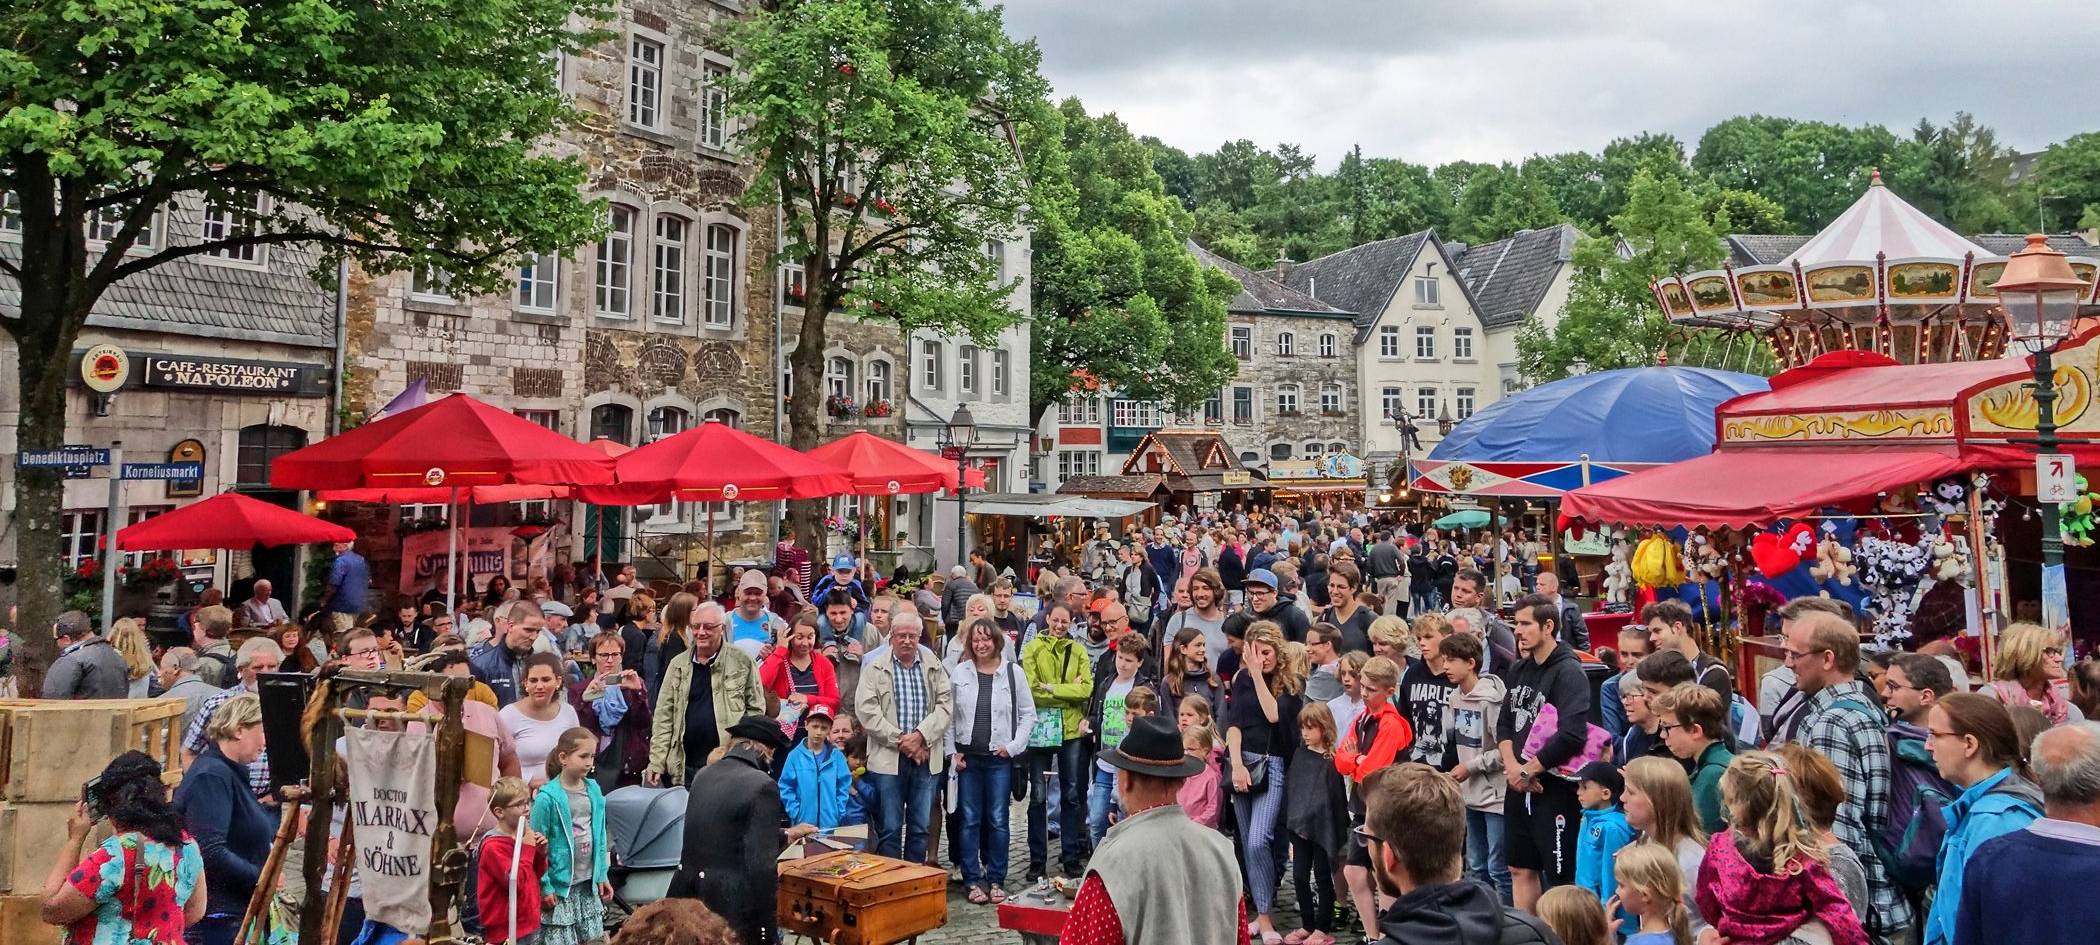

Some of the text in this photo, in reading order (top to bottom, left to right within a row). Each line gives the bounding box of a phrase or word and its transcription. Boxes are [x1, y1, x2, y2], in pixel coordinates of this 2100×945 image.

[156, 360, 297, 378] CAFE-RESTAURANT
[175, 371, 278, 389] NAPOLEON
[22, 451, 105, 465] Benediktusplatz
[125, 465, 198, 479] Korneliusmarkt
[1410, 683, 1452, 705] MARLE
[356, 801, 430, 836] MARRAX
[386, 830, 394, 850] &
[1552, 814, 1566, 875] Champion
[363, 846, 421, 876] SÖHNE
